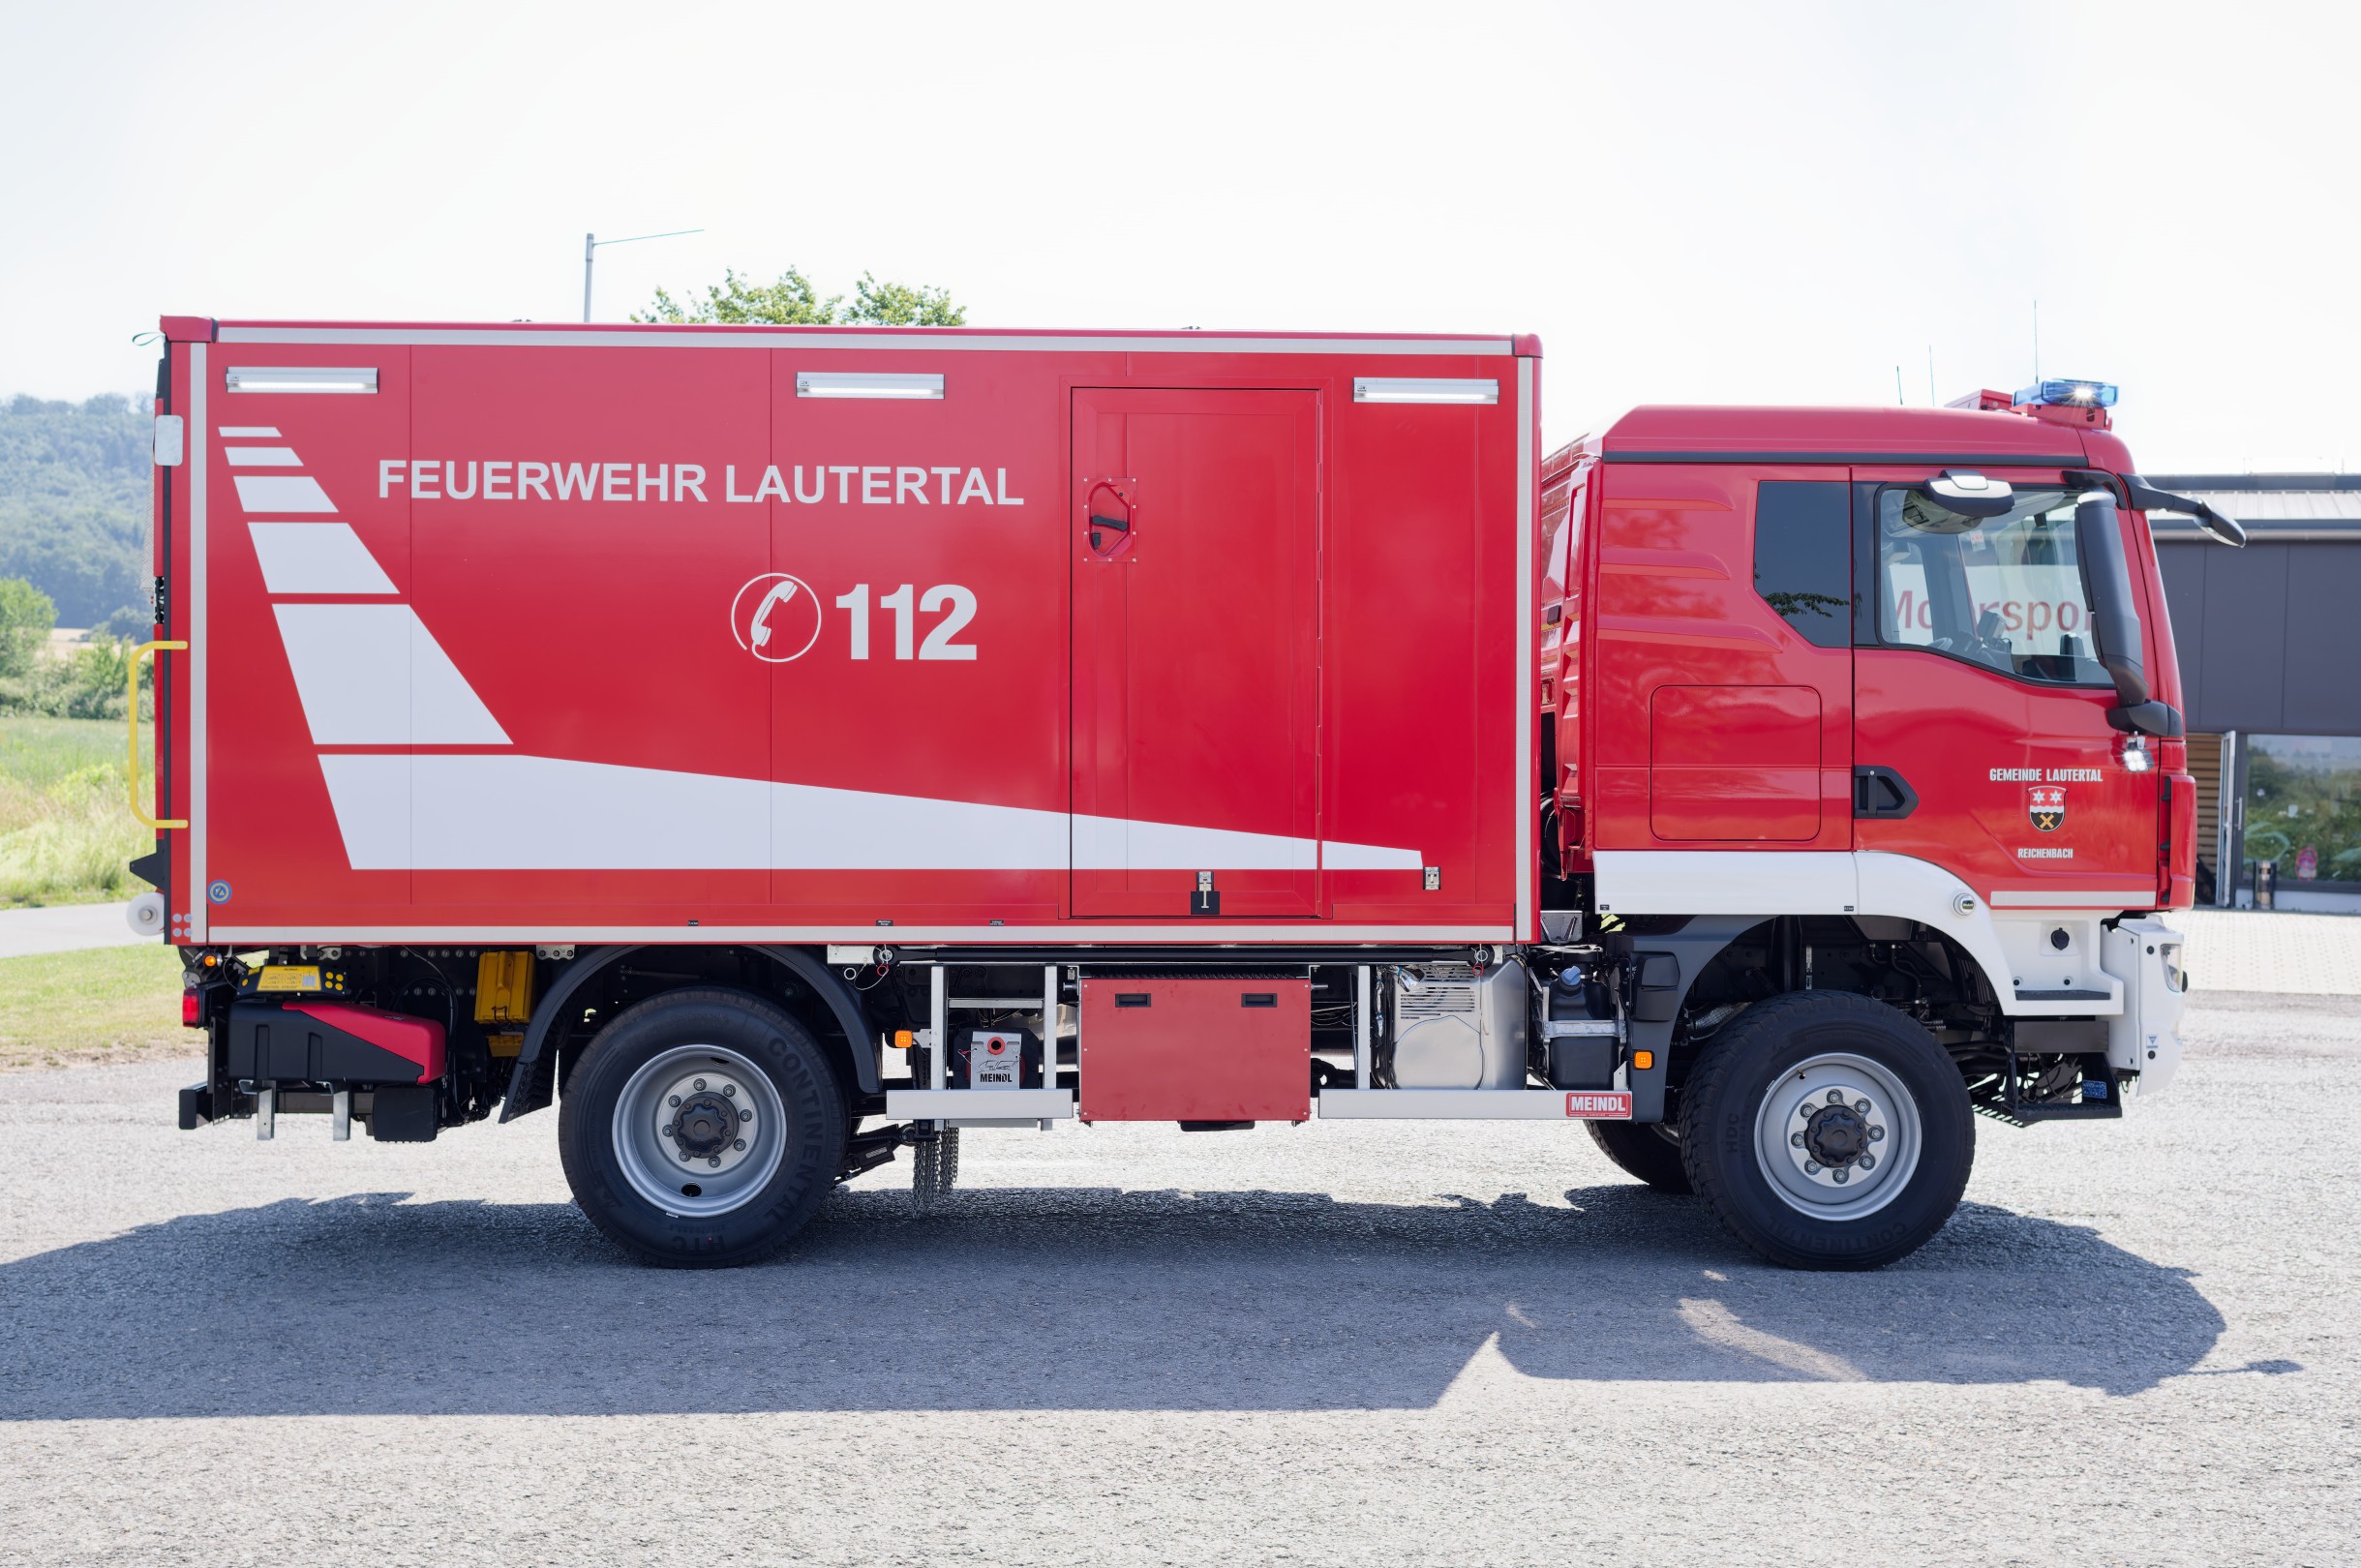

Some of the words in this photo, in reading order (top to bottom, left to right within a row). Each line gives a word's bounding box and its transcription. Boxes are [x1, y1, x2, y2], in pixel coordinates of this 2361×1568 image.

[378, 459, 709, 502] FEUERWEHR
[725, 465, 1024, 505] LAUTERTAL
[835, 583, 978, 661] 112
[1989, 768, 2043, 782] GEMEINDE
[2045, 769, 2104, 782] LAUTERTAL
[2017, 848, 2073, 859] REICHENBACH
[980, 1073, 1013, 1082] MEINDL
[1571, 1096, 1626, 1111] MEINDL
[763, 1037, 824, 1220] CONTINENTAL
[1768, 1216, 1908, 1252] CONTINENTAL
